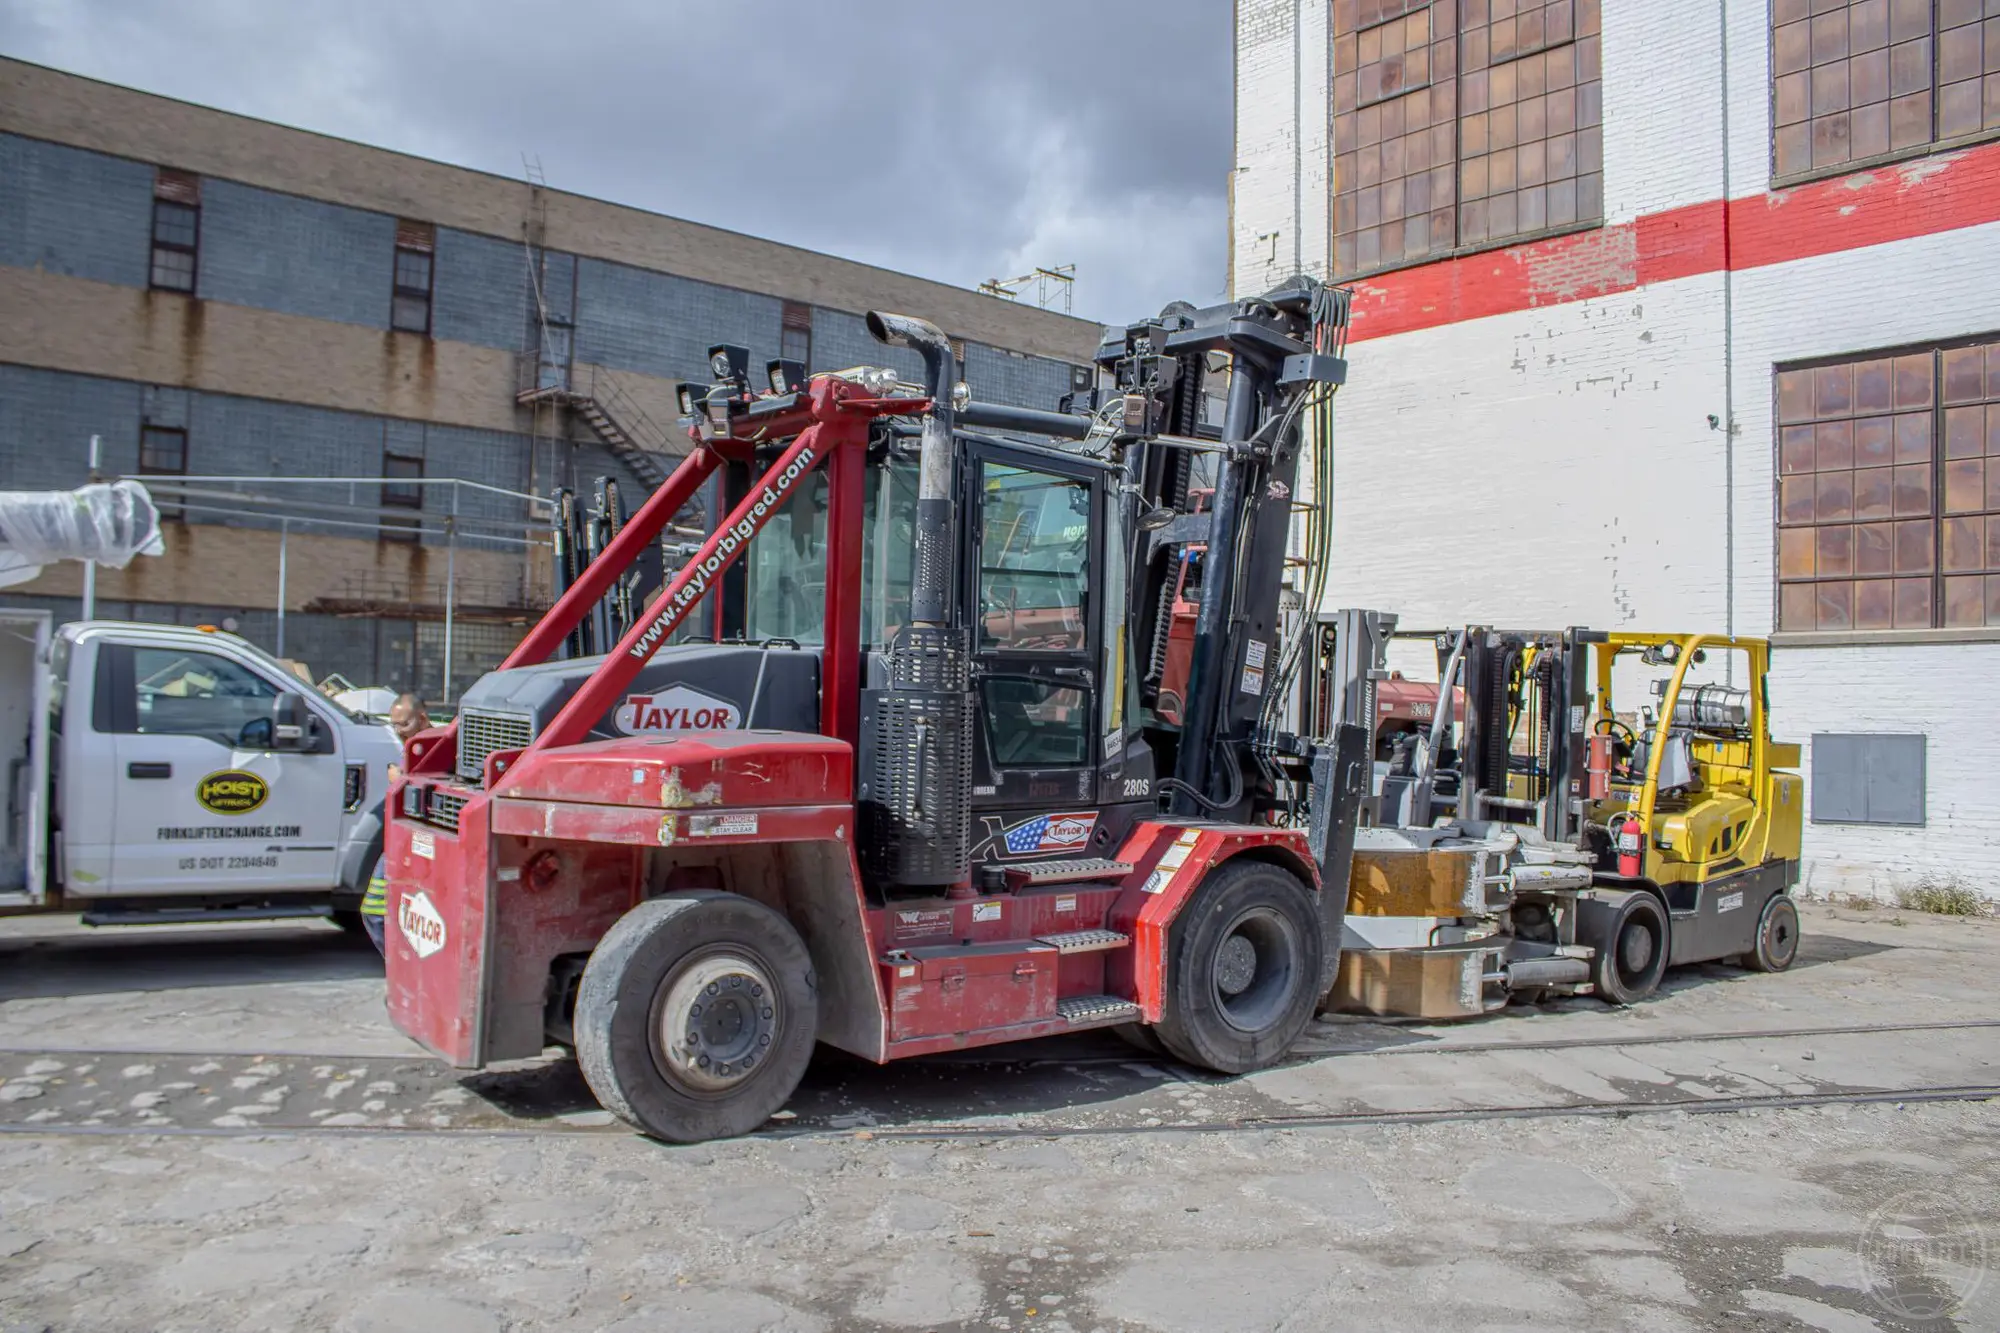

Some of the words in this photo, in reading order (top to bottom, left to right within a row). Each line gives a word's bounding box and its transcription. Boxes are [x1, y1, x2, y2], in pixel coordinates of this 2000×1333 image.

[630, 447, 815, 658] www.taylorbigred.com
[626, 696, 729, 729] TAYLOR
[202, 780, 263, 800] HOIST
[1123, 779, 1150, 797] 280S
[723, 814, 755, 823] DANGER
[157, 825, 302, 840] FORKLIFTEXCHANGE.COM
[1053, 824, 1082, 836] TAYLOR
[179, 858, 196, 870] US
[400, 896, 442, 945] TAYLOR
